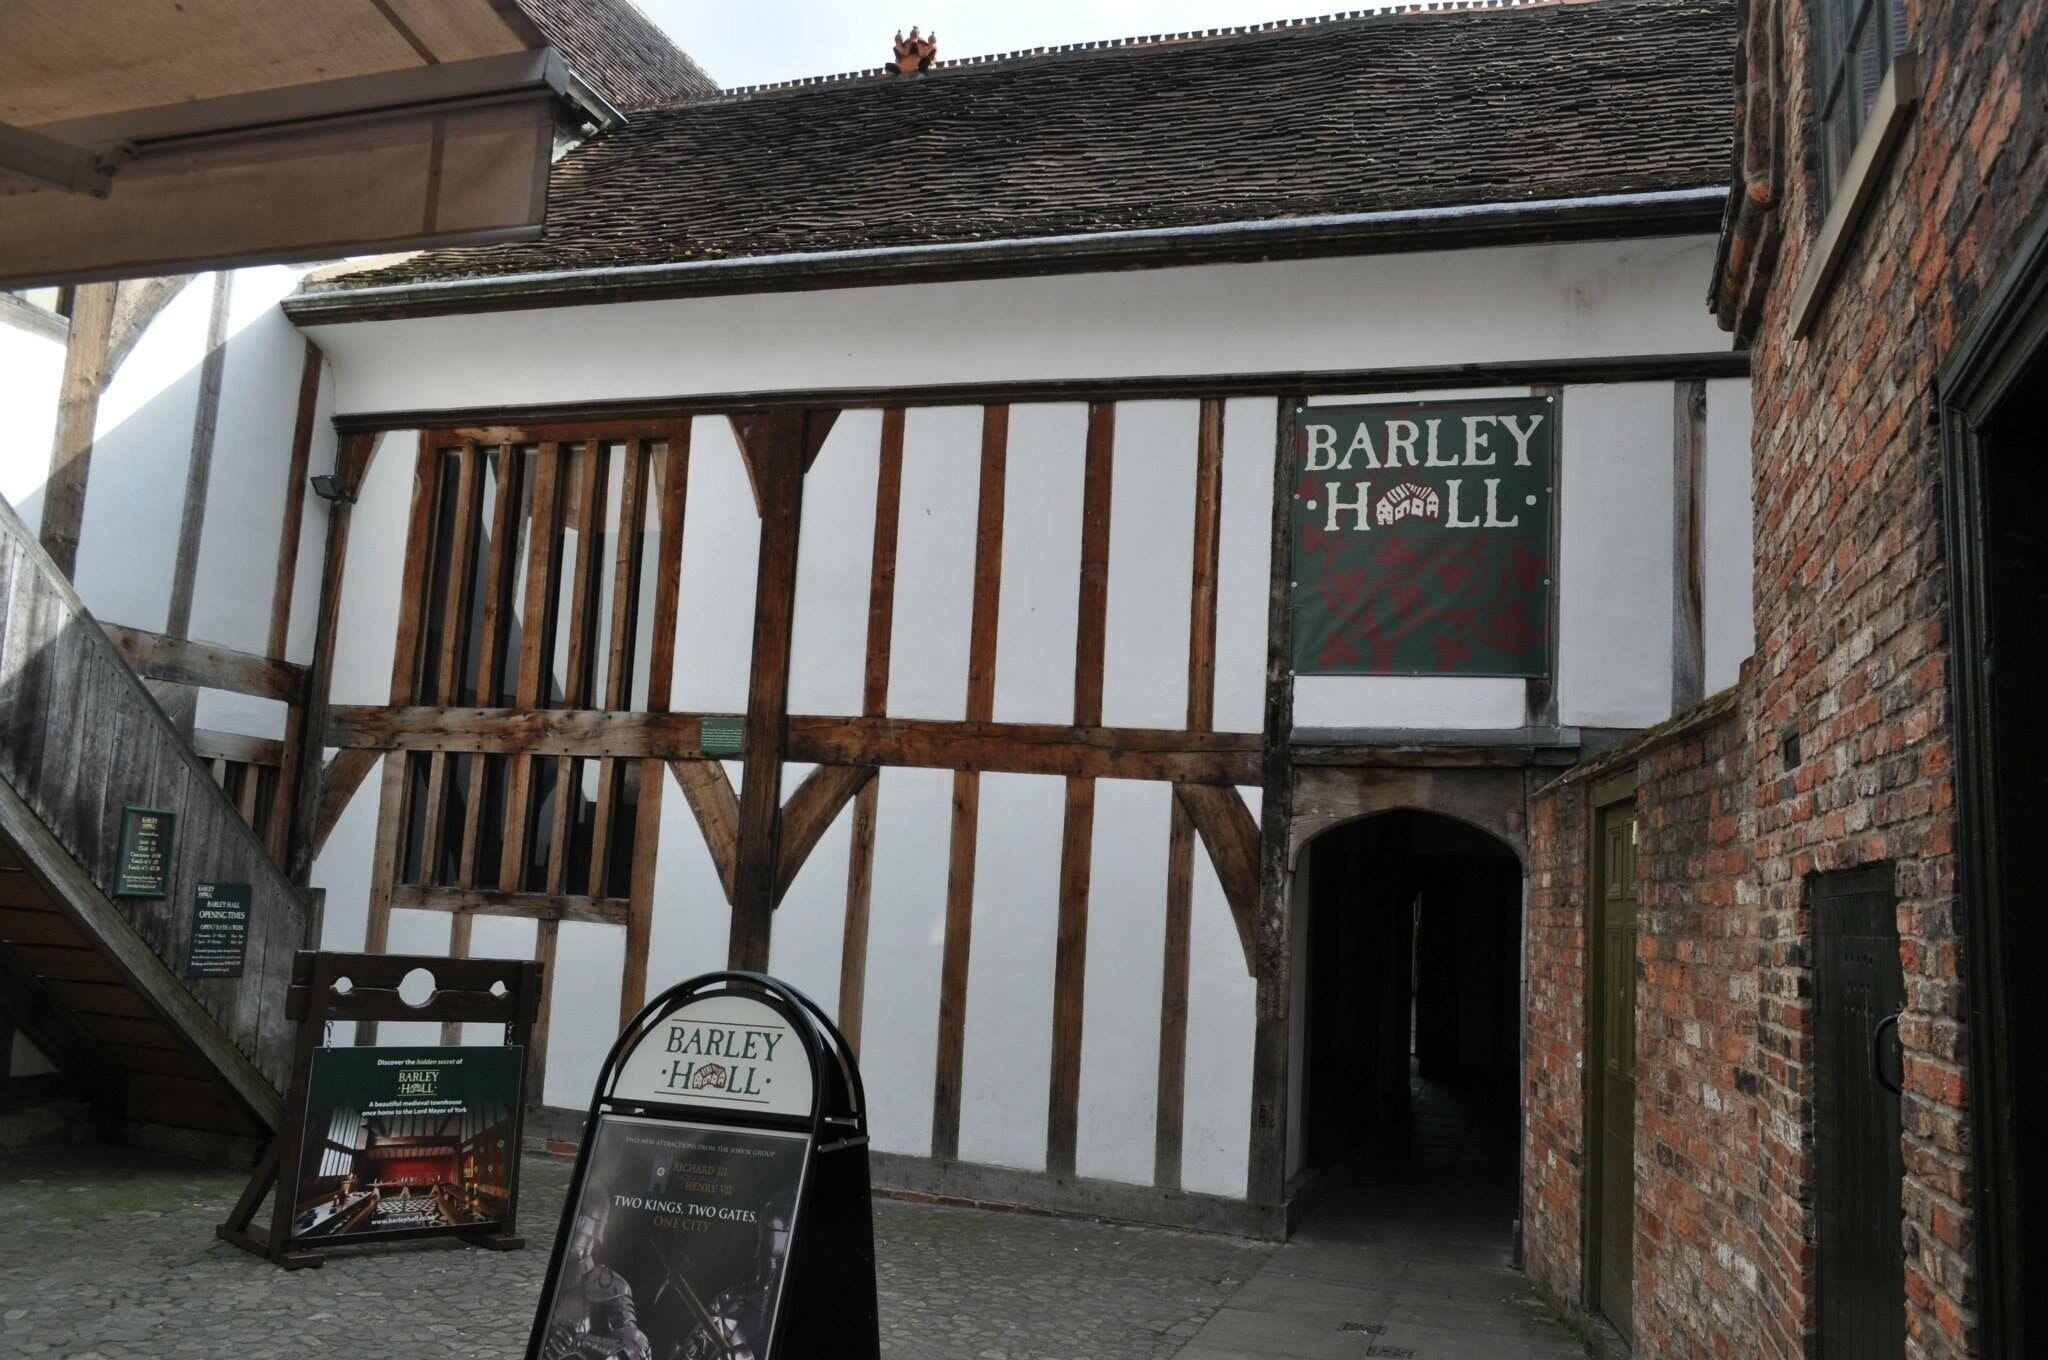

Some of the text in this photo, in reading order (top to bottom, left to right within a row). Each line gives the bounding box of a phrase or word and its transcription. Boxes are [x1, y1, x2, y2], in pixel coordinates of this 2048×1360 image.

[1304, 414, 1544, 471] BARLEY
[226, 901, 241, 909] HALL
[198, 910, 246, 919] OPENING TIMES
[665, 1026, 784, 1062] BARLEY
[398, 1071, 440, 1083] BARLEY
[374, 1100, 402, 1108] beautiful
[625, 1136, 640, 1144] TWO
[655, 1139, 697, 1150] ATTRACTIONS
[698, 1144, 716, 1152] FROM
[717, 1145, 729, 1153] THE
[752, 1149, 776, 1158] GROUP
[672, 1161, 729, 1177] RICHARD III
[683, 1180, 719, 1193] HENRY
[613, 1195, 642, 1210] TWO
[687, 1203, 717, 1219] TWO
[718, 1207, 758, 1224] GATES.
[653, 1215, 712, 1233] ONE CITY
